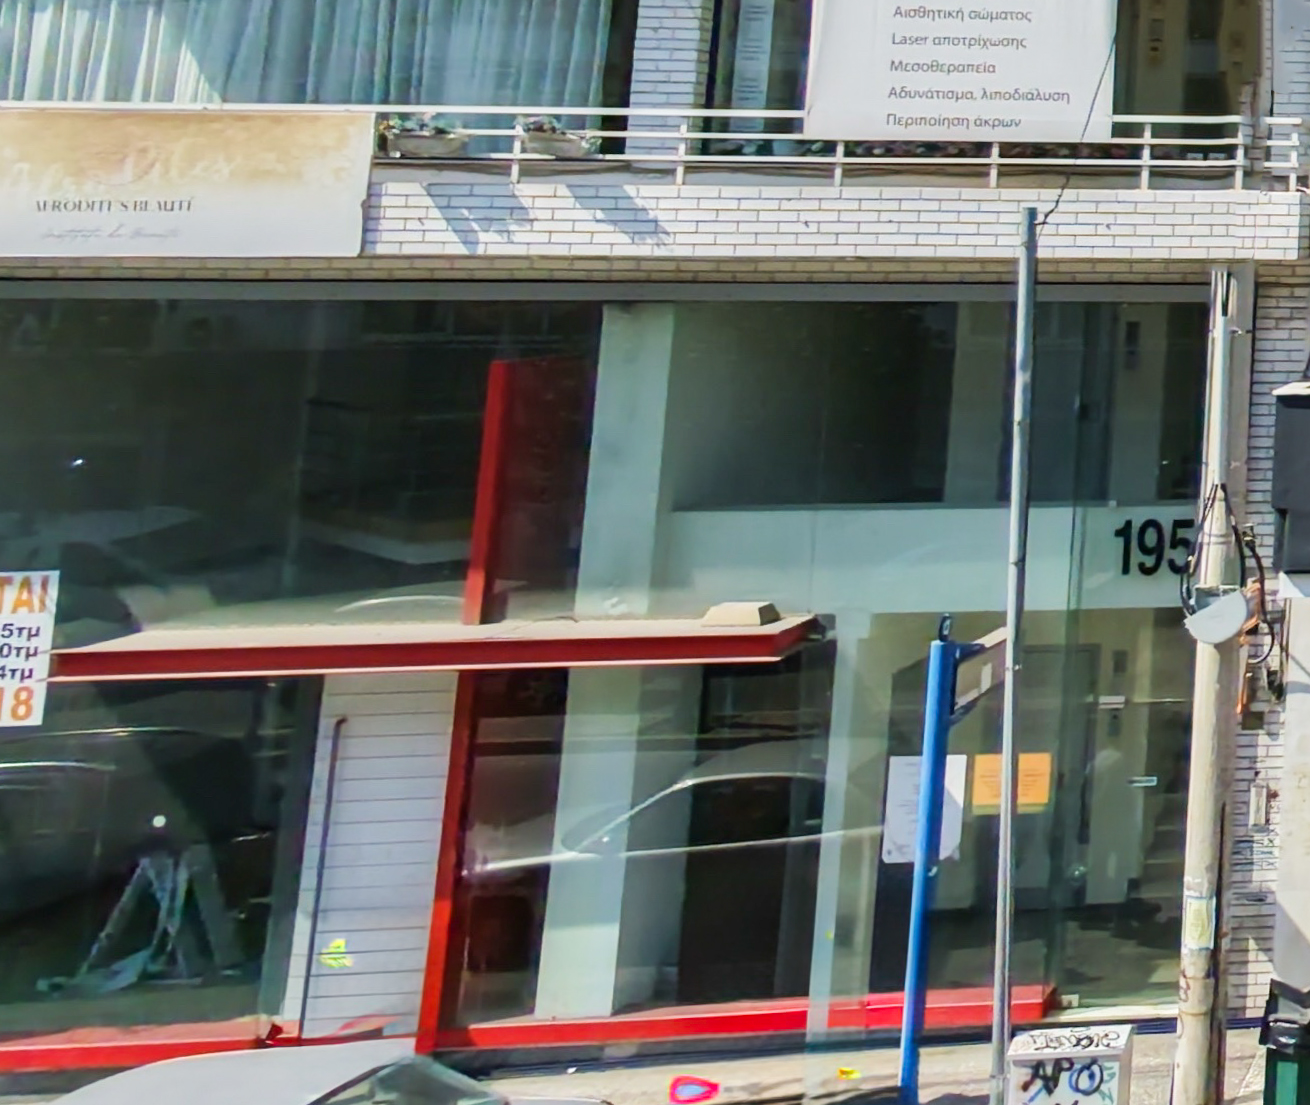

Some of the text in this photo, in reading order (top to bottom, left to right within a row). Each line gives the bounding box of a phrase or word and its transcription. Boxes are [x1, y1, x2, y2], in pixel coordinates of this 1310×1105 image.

[892, 5, 1032, 24] Αισθητική σώματος
[891, 32, 1028, 50] Laser αποτρίχωσης
[889, 59, 997, 76] Μεσοθεραπεία
[980, 86, 1071, 104] λιποδιάλυση
[886, 112, 1022, 130] Περιποίηση άκρων
[1114, 518, 1195, 576] 195
